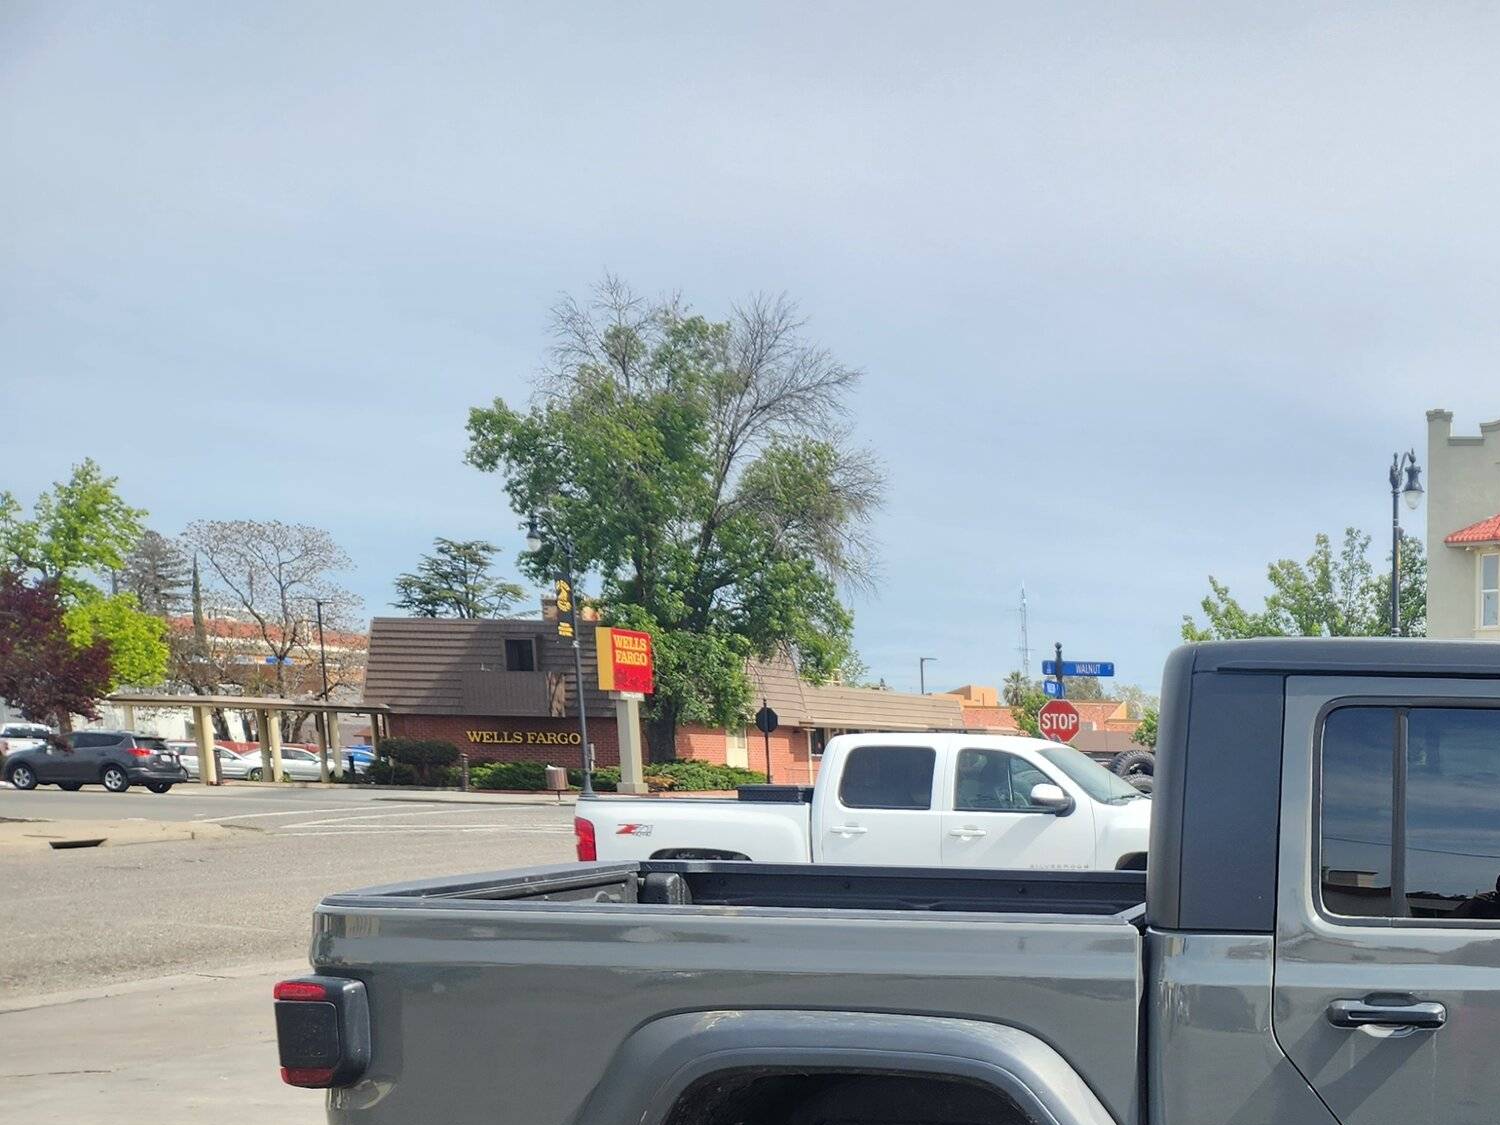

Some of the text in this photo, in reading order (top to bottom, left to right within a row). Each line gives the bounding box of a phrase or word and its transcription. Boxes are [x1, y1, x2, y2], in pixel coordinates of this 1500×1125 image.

[612, 633, 647, 652] WELLS
[615, 649, 648, 667] FARGO
[1075, 663, 1101, 674] WALNUT
[1041, 713, 1078, 730] STOP
[466, 730, 582, 745] WELLS FARGO
